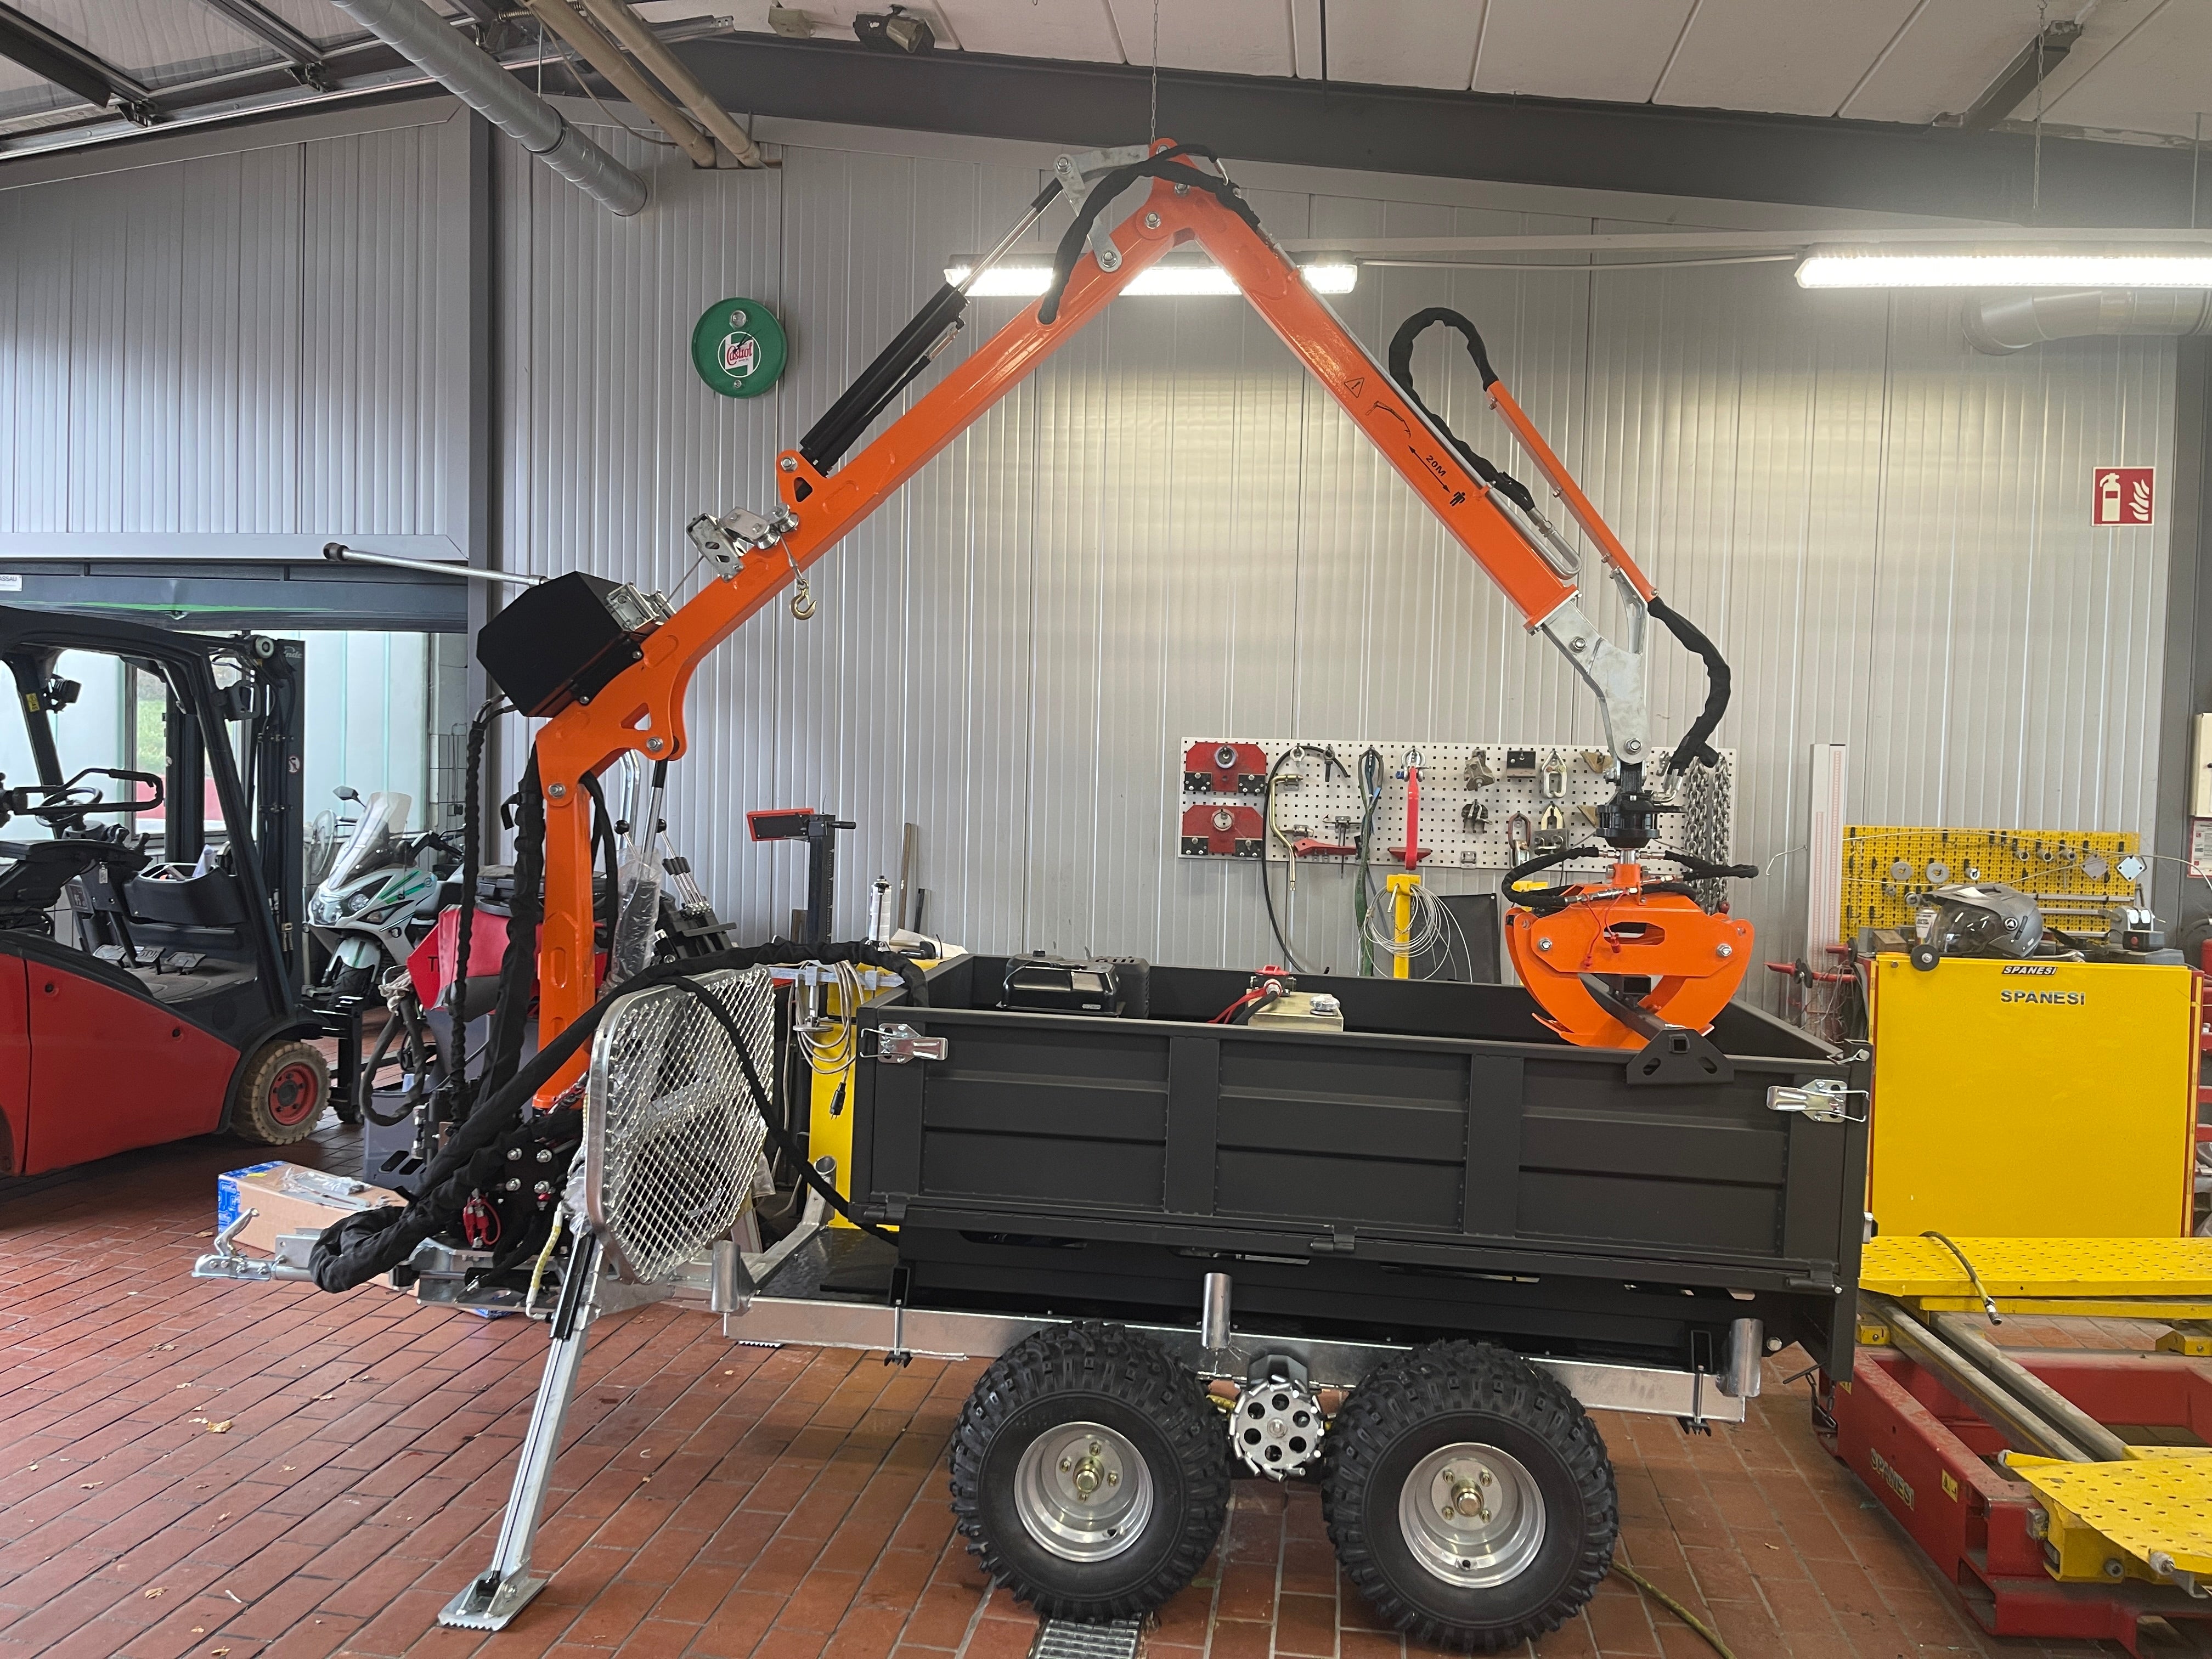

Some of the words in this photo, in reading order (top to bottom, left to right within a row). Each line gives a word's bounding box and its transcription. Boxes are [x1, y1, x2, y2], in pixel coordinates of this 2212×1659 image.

[727, 342, 753, 366] Castrol
[1426, 455, 1447, 477] 20M
[2004, 966, 2057, 975] SPANESI
[2000, 990, 2085, 1006] SPANESI
[1870, 1448, 1914, 1511] SPANESI
